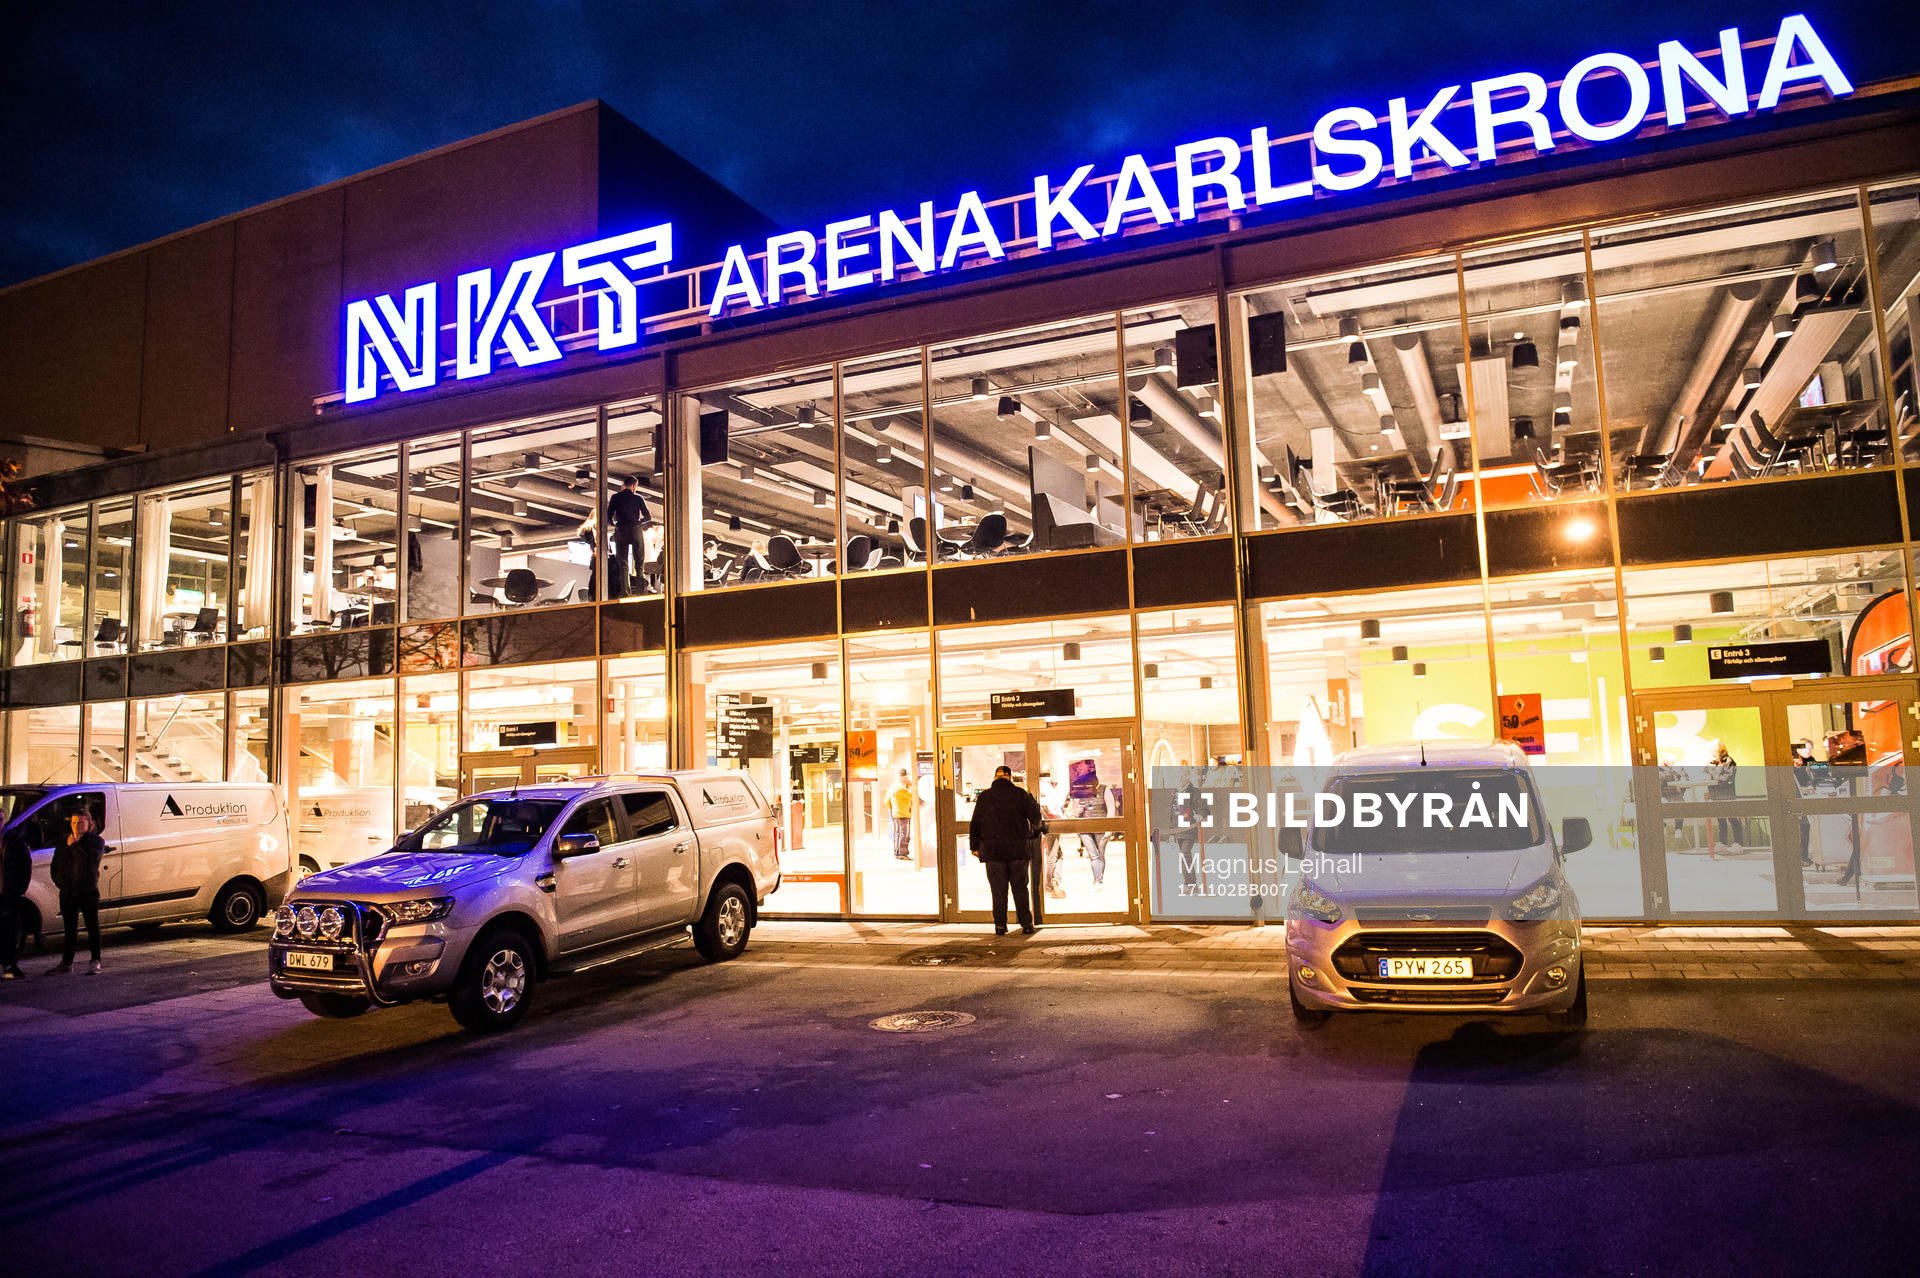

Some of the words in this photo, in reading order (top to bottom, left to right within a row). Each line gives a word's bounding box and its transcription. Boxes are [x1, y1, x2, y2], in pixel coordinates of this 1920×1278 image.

[345, 222, 672, 403] NKT
[709, 191, 1005, 316] ARENA
[1034, 14, 1854, 250] KARLSKRONA
[1723, 650, 1744, 658] Entré
[185, 802, 247, 816] Produktion
[289, 953, 307, 967] DWL
[309, 955, 329, 968] 679
[1395, 960, 1426, 975] PYW
[1432, 960, 1464, 975] 265
